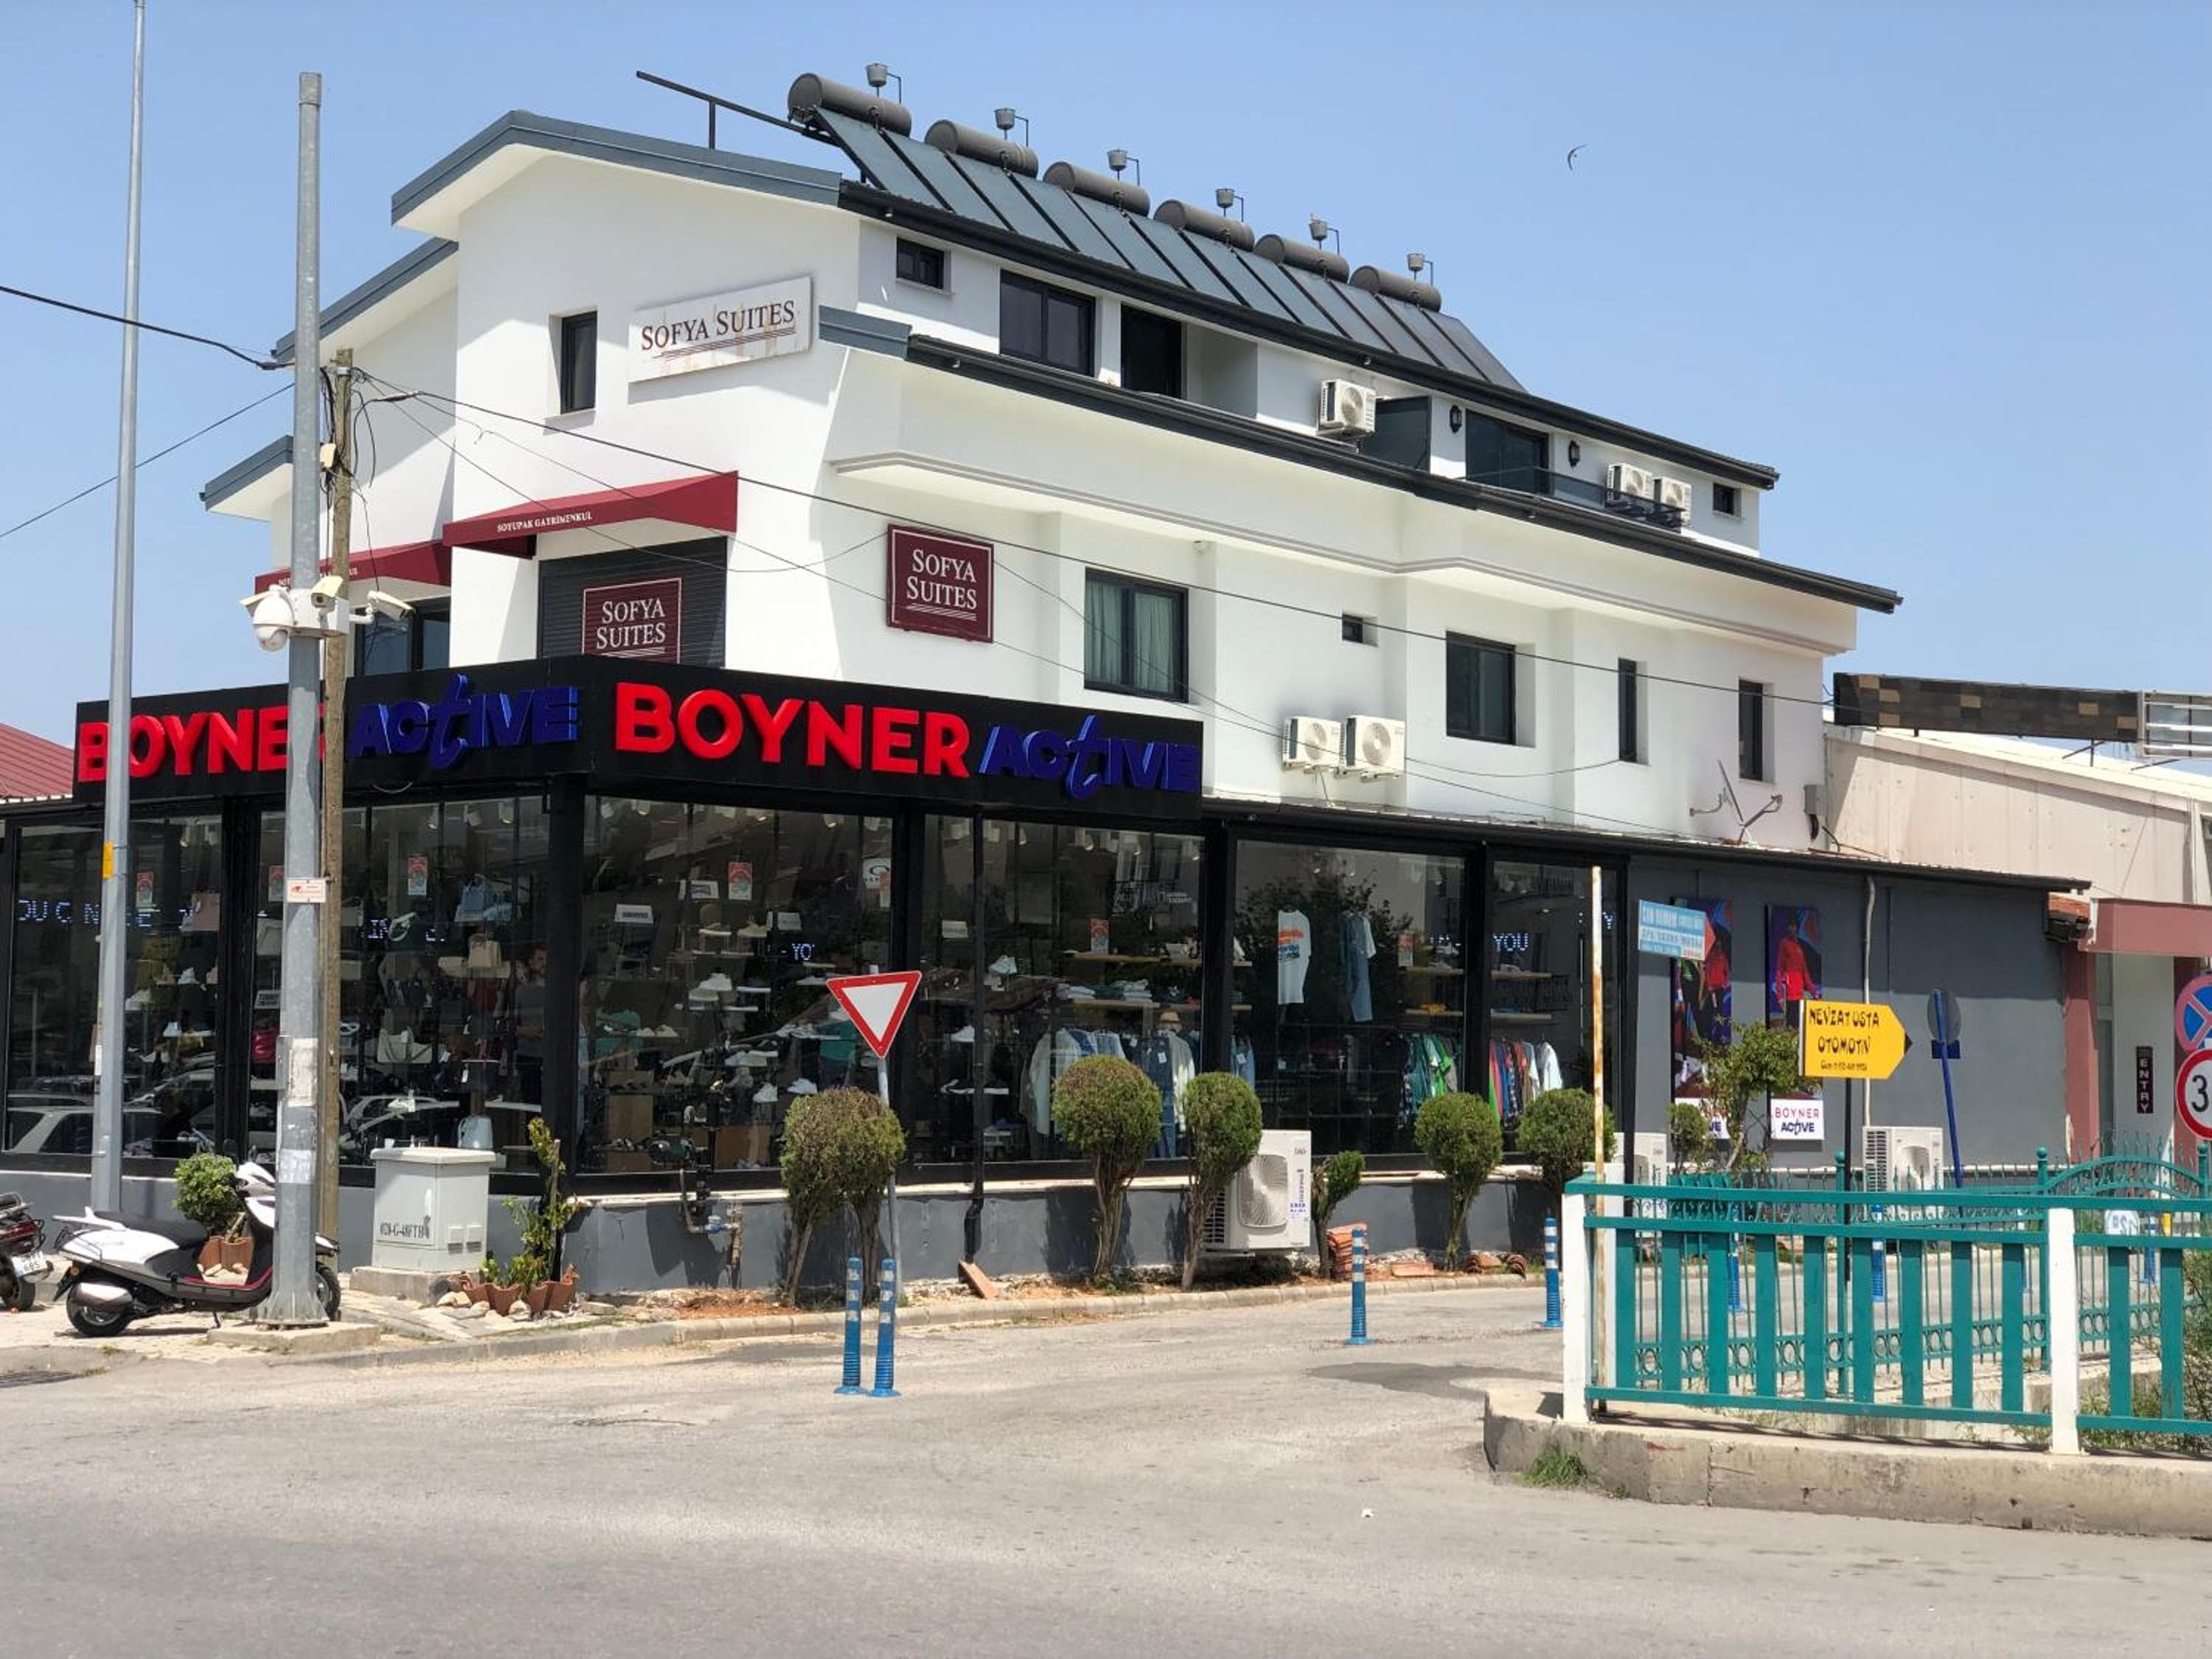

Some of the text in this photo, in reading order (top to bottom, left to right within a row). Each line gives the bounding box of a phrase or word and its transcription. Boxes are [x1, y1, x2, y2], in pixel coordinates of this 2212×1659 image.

[641, 300, 795, 350] SOFYA SUITES
[912, 549, 977, 583] SOFYA
[906, 576, 977, 610] SUITES
[602, 598, 665, 624] SOFYA
[597, 622, 666, 650] SUITES
[77, 702, 326, 783] BOYNE
[616, 682, 970, 778] BOYNER
[1493, 932, 1528, 952] YOU
[1809, 1007, 1879, 1027] NEVZAT USTA
[2139, 1058, 2150, 1113] ENTRY
[1775, 1107, 1819, 1119] BOYNER
